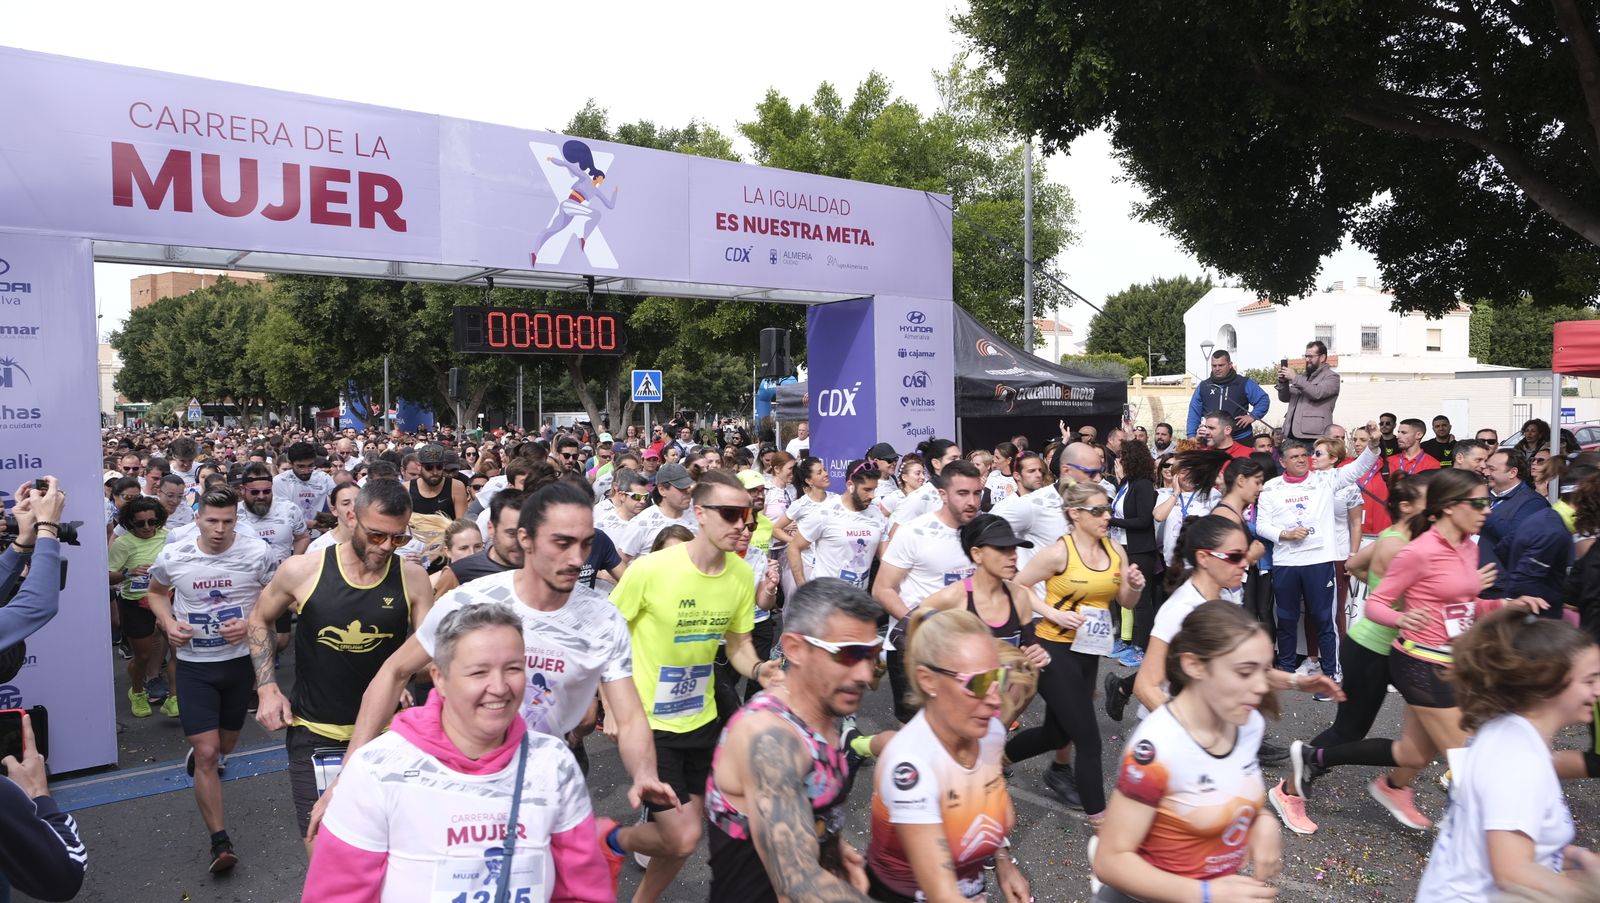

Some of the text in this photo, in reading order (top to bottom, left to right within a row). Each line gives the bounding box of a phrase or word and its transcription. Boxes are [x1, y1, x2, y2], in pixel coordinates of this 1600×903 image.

[129, 102, 391, 160] CARRERA DE LA
[111, 141, 407, 232] MUJER
[743, 185, 850, 216] LA IGUALDAD
[716, 212, 874, 246] ES NUESTRA META.
[725, 246, 753, 263] CDX
[783, 251, 813, 261] ALMERÍA
[488, 311, 615, 350] 00:00:00
[900, 325, 933, 334] HYUNDAI
[908, 350, 936, 358] cajamar
[903, 374, 926, 388] CASI
[818, 382, 862, 416] CDX
[911, 397, 935, 407] vithas
[0, 405, 41, 420] has
[907, 425, 935, 437] aqualia
[1285, 495, 1310, 504] MUJER
[192, 579, 233, 590] MUJER
[201, 622, 225, 635] 13
[524, 655, 565, 673] UJER
[670, 678, 697, 696] 489
[451, 813, 496, 823] CARRERA
[447, 823, 527, 847] MUJER
[453, 872, 480, 880] MUJER
